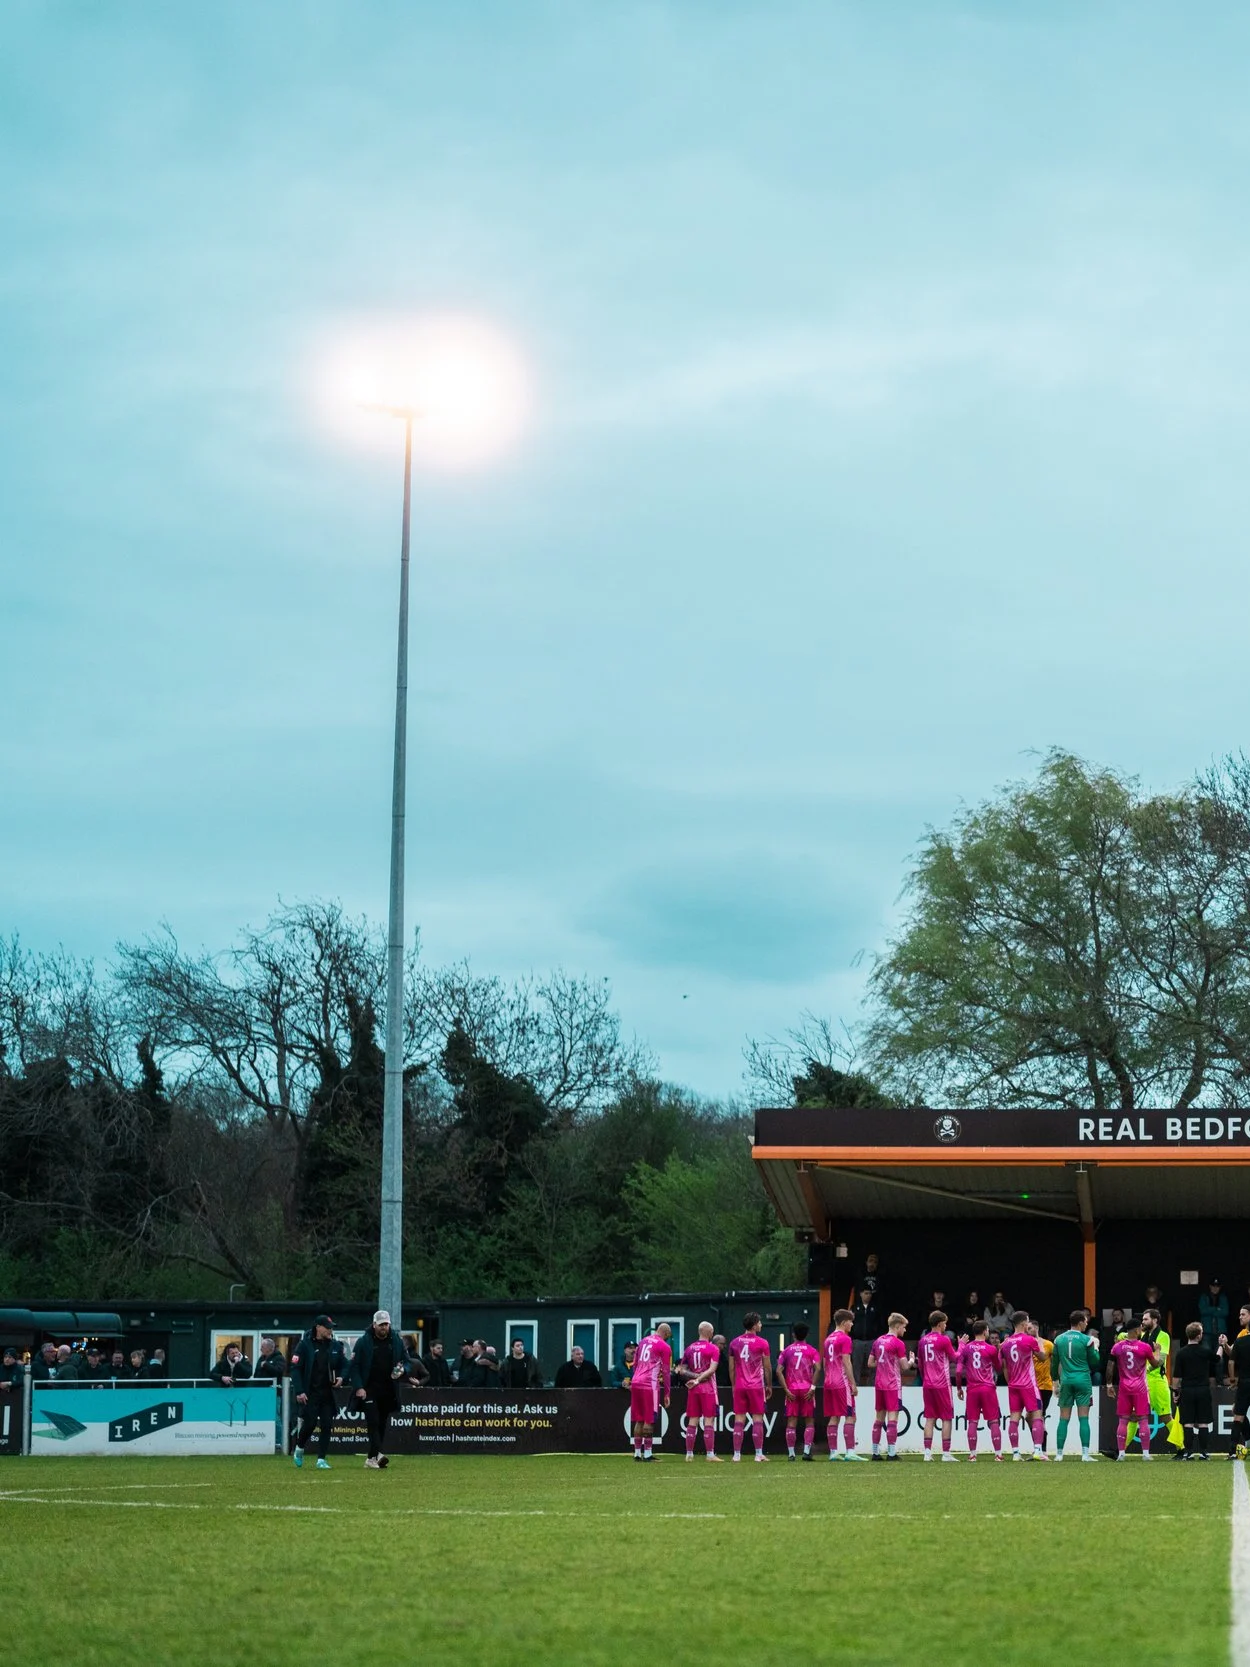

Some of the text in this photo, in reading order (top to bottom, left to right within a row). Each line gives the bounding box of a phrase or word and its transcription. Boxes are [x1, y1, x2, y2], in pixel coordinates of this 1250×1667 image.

[1079, 1118, 1153, 1141] REAL
[639, 1344, 653, 1362] 16
[740, 1345, 750, 1362] 4
[828, 1344, 834, 1362] 9
[878, 1346, 885, 1363] 2
[924, 1344, 935, 1362] 15
[1010, 1344, 1019, 1363] 6
[1068, 1341, 1072, 1359] 1
[693, 1352, 702, 1369] 11
[794, 1352, 803, 1370] 7
[972, 1352, 981, 1369] 8
[1126, 1351, 1134, 1369] 3
[401, 1404, 558, 1415] ashrate paid for this ad. Ask us
[115, 1406, 176, 1438] IREN
[390, 1417, 552, 1430] how hashrate can work for you.
